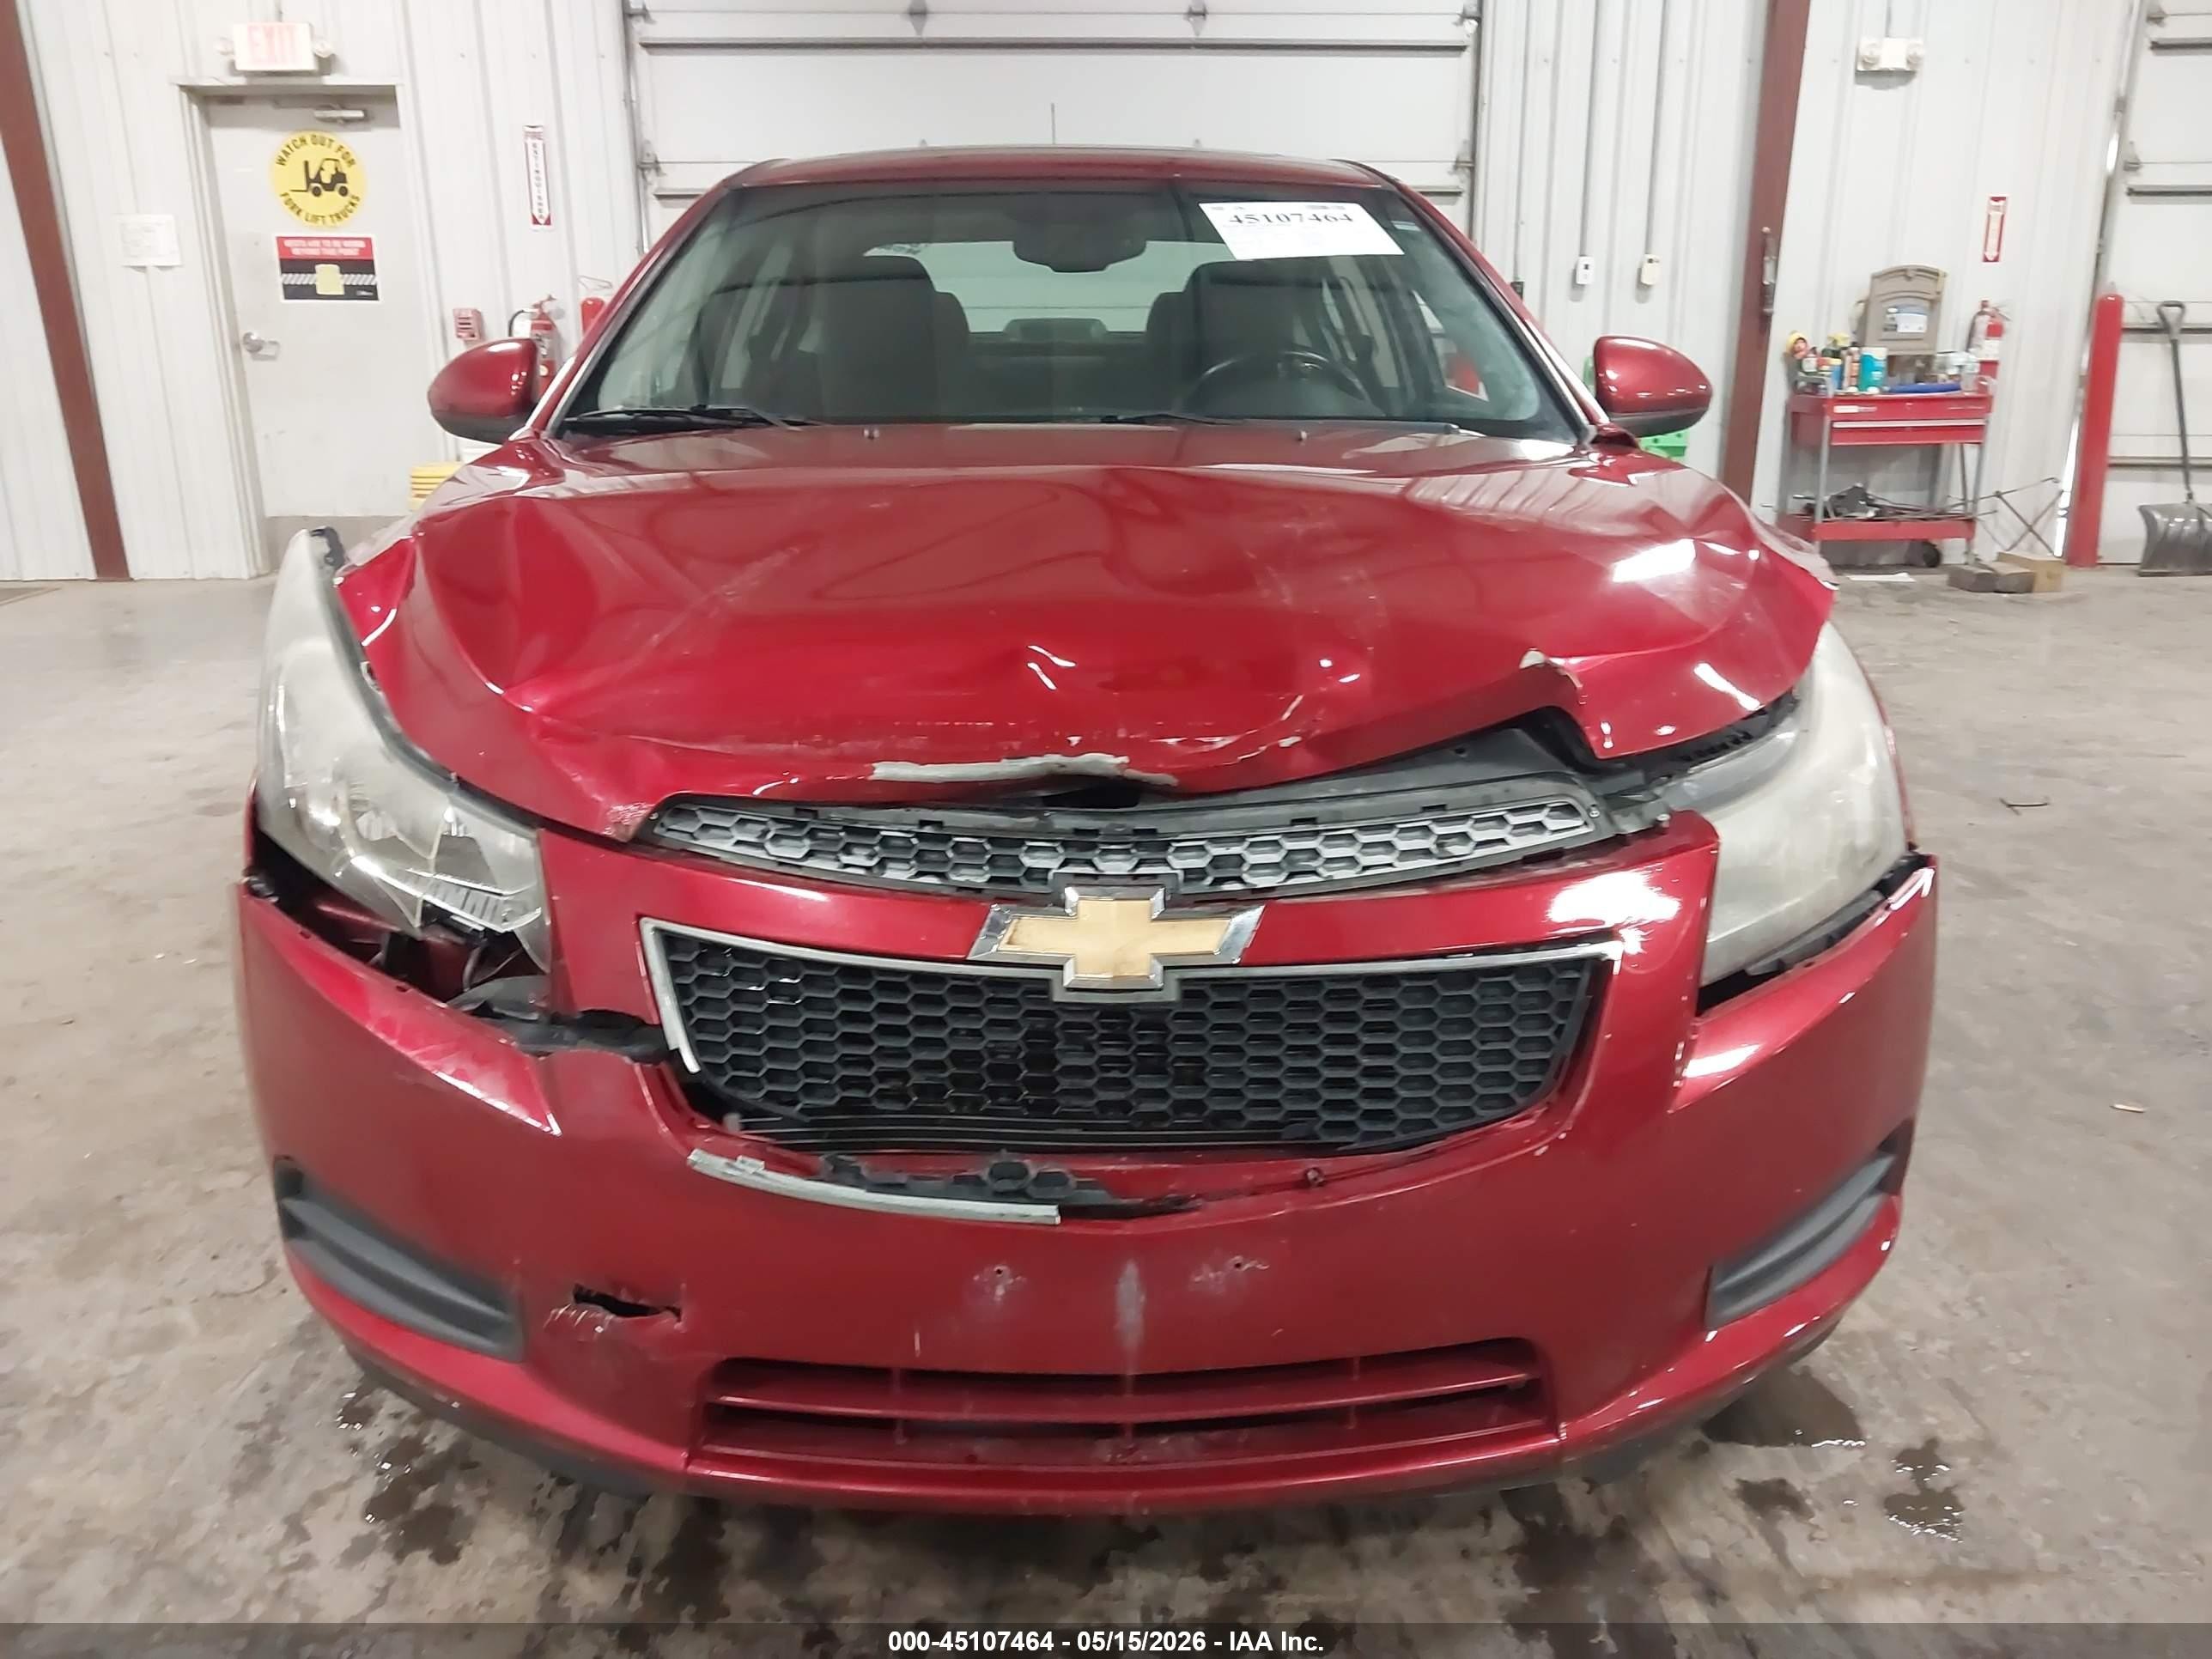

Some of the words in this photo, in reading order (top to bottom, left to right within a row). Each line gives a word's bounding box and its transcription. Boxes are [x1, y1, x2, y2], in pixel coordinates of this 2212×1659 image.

[247, 24, 297, 64] EXIT
[276, 136, 308, 166] WATCH
[310, 134, 335, 149] OUT
[334, 144, 356, 168] FOR
[279, 191, 303, 216] FORK
[304, 211, 325, 224] LIFT
[328, 195, 361, 223] TRUCKS
[1229, 212, 1354, 224] 45107464
